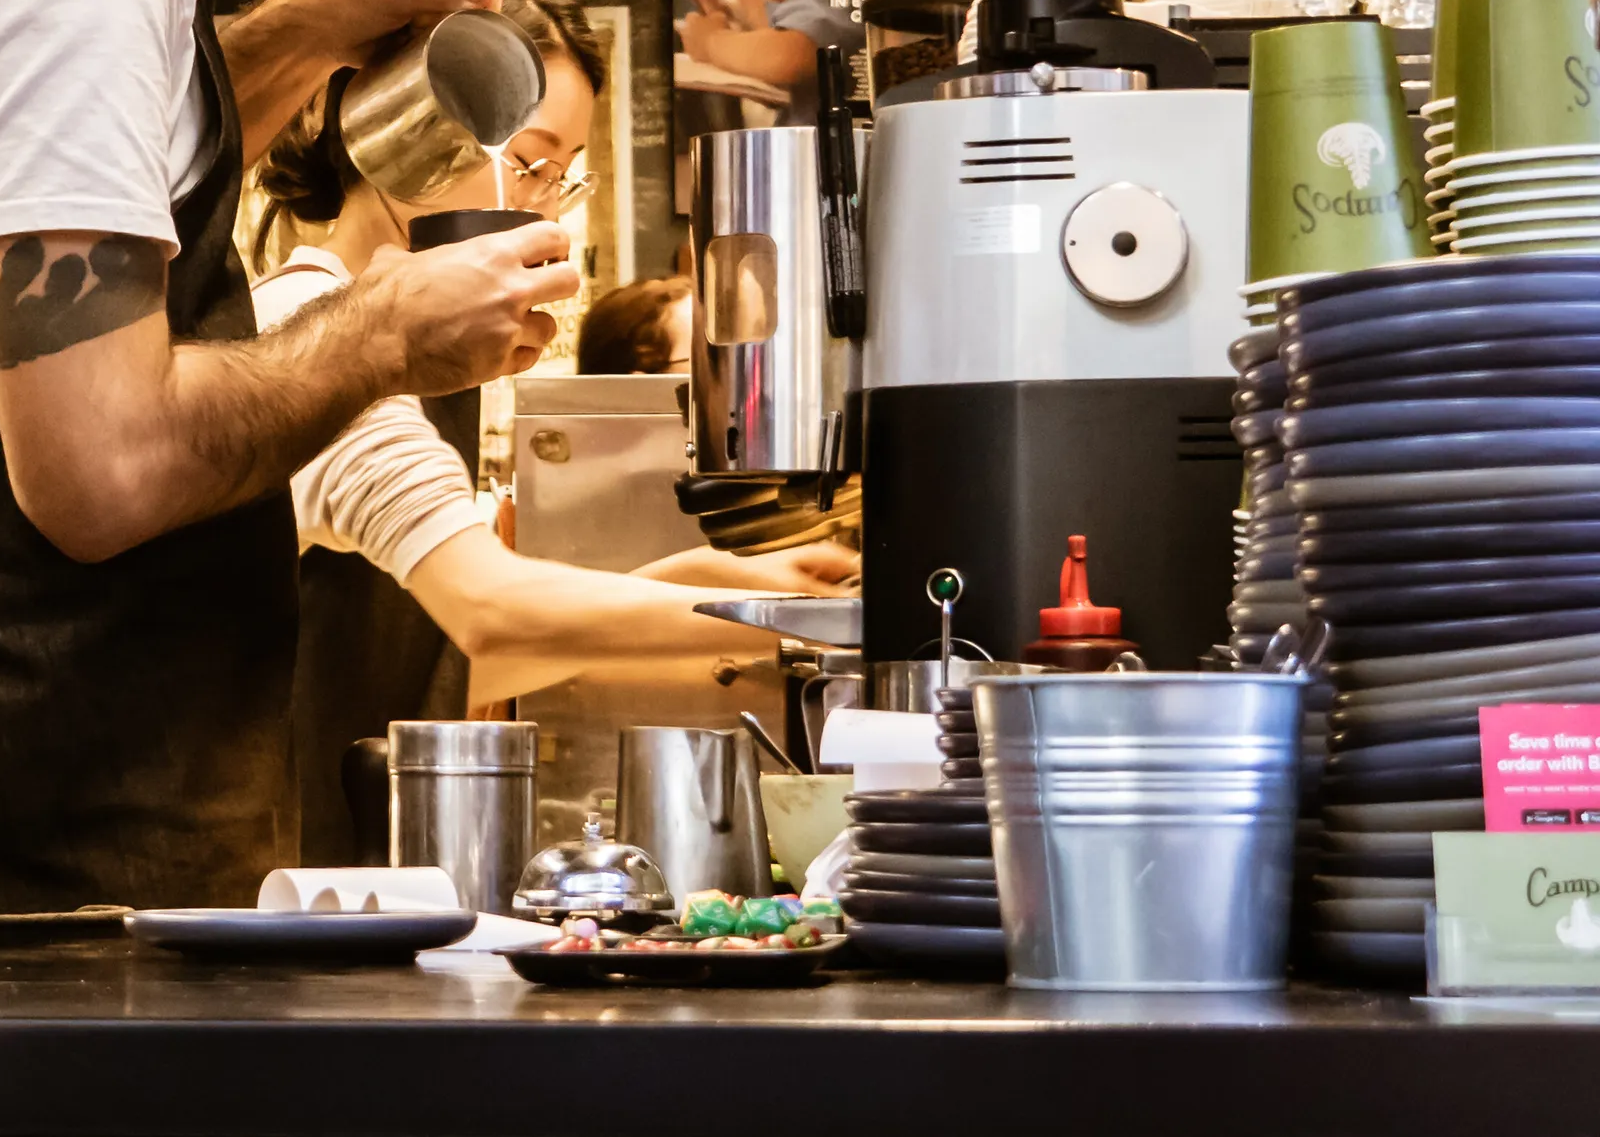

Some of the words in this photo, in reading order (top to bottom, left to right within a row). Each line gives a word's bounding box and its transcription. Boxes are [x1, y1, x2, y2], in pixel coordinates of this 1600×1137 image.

[1508, 733, 1549, 750] Save
[1553, 733, 1591, 750] time
[1497, 755, 1542, 772] order
[1546, 755, 1583, 771] with
